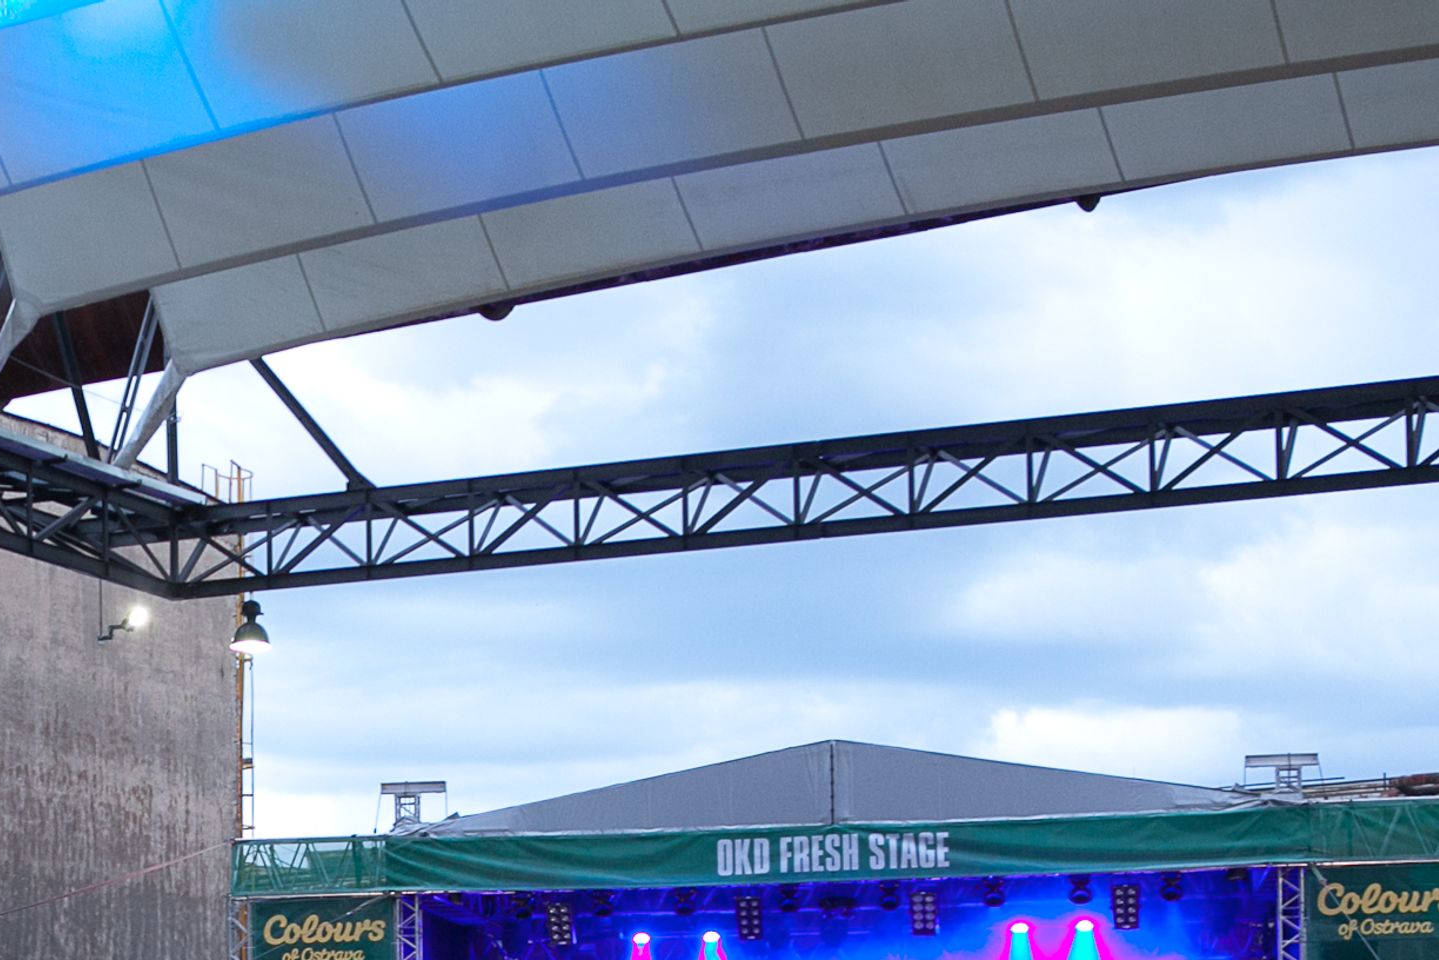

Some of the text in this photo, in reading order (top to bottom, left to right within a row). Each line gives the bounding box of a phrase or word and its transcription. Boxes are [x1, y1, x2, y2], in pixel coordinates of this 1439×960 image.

[717, 831, 950, 876] OKD FRESH STAGE
[1317, 882, 1439, 916] Colour
[263, 914, 386, 945] Colours
[1338, 918, 1434, 940] of Ostrava
